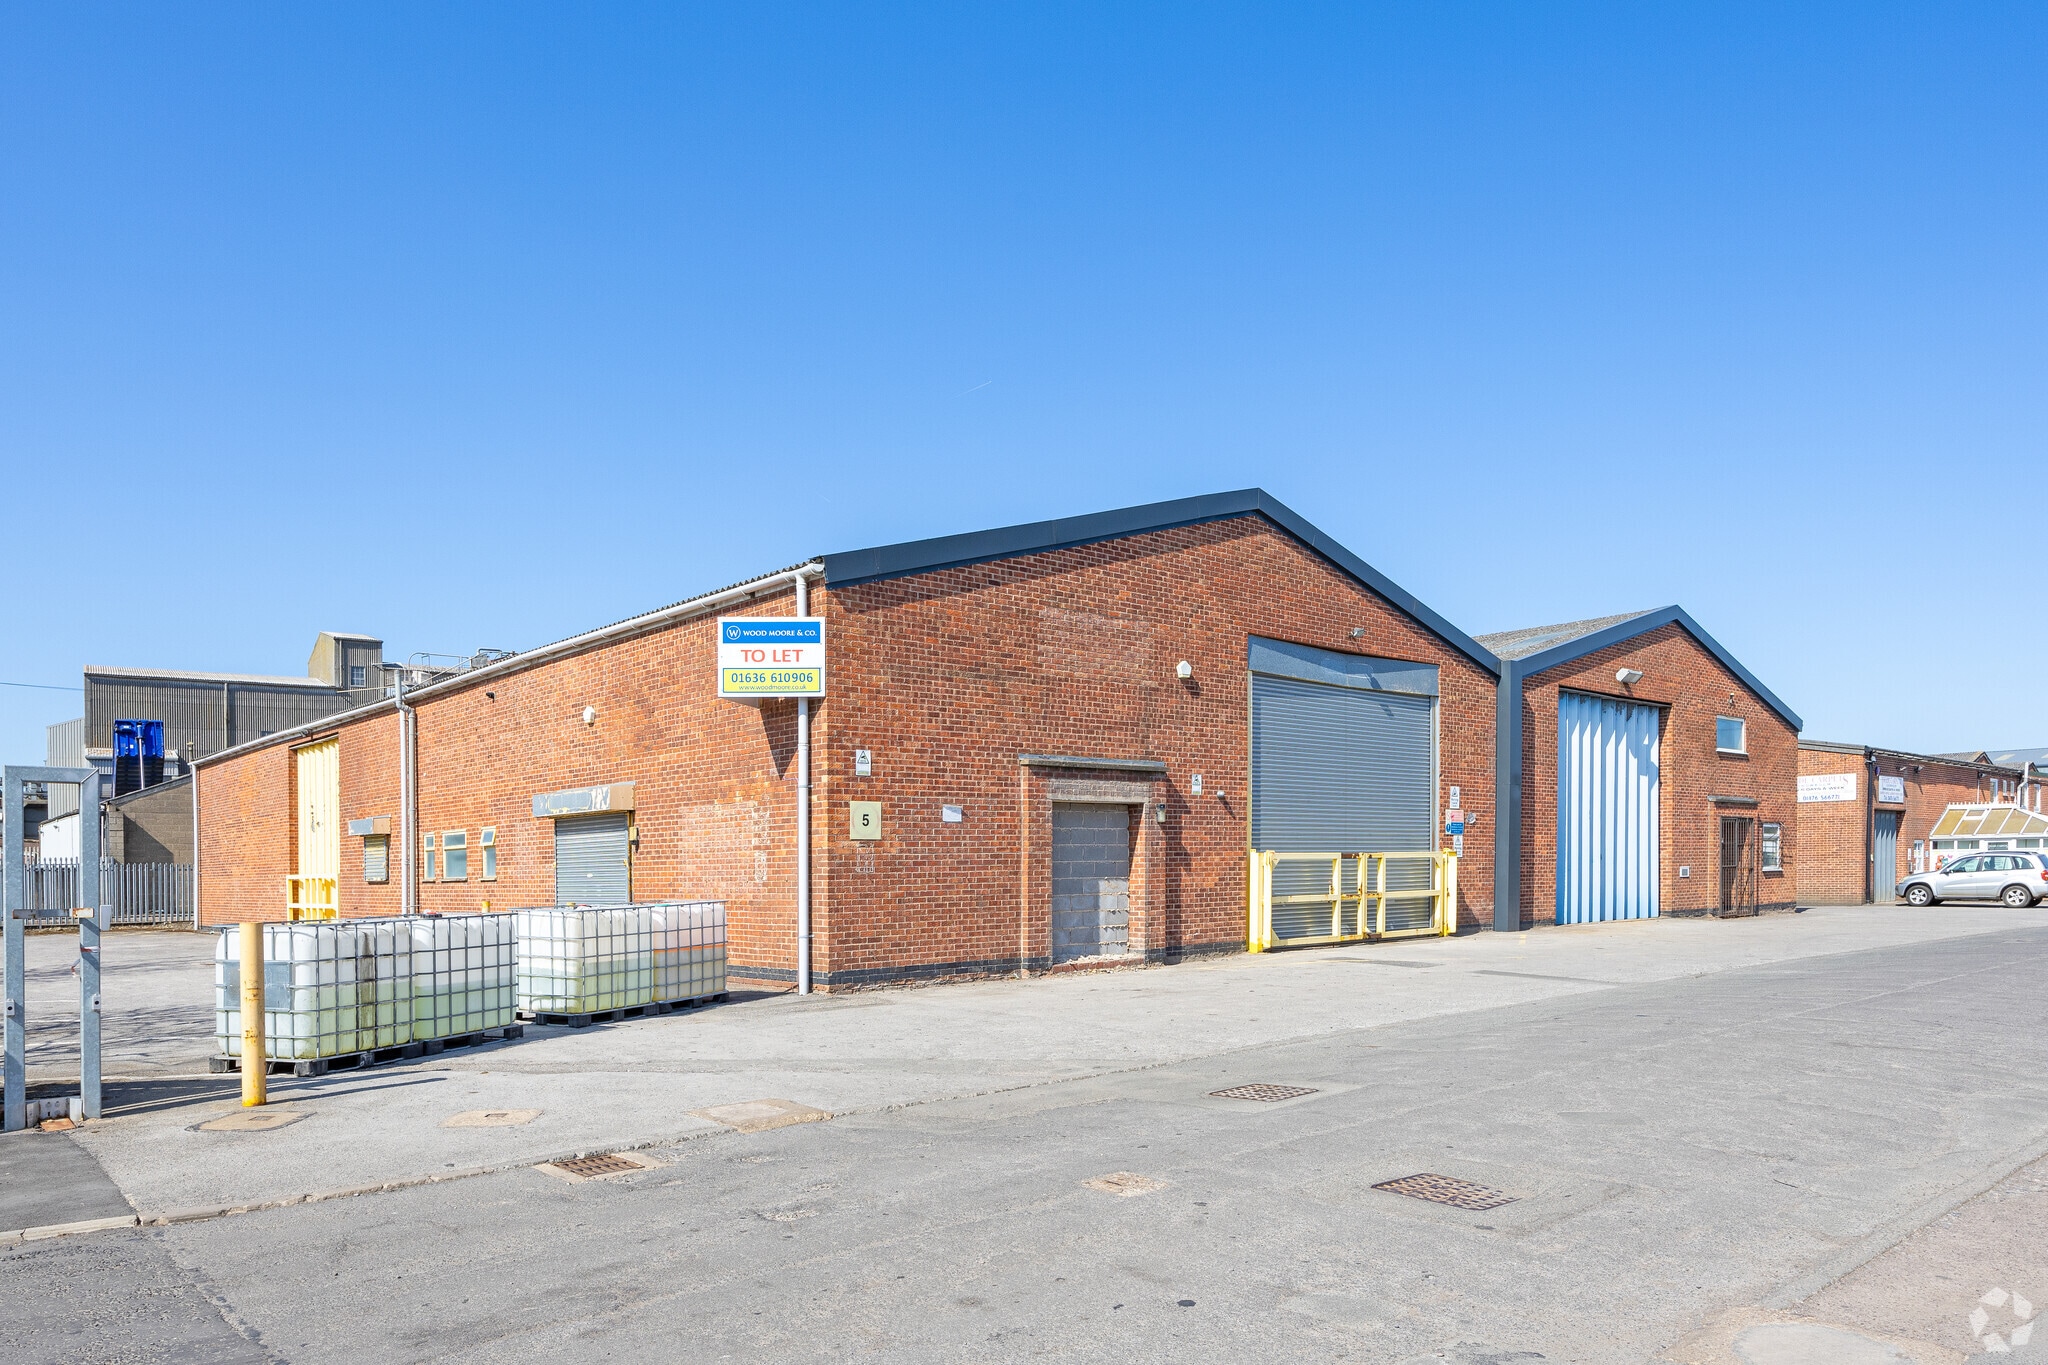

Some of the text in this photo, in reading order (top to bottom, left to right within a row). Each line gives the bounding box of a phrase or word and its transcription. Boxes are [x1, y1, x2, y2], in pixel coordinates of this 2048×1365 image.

[797, 629, 803, 637] &
[740, 649, 804, 663] TO LET
[731, 673, 813, 683] 01636 610906
[862, 813, 870, 827] 5
